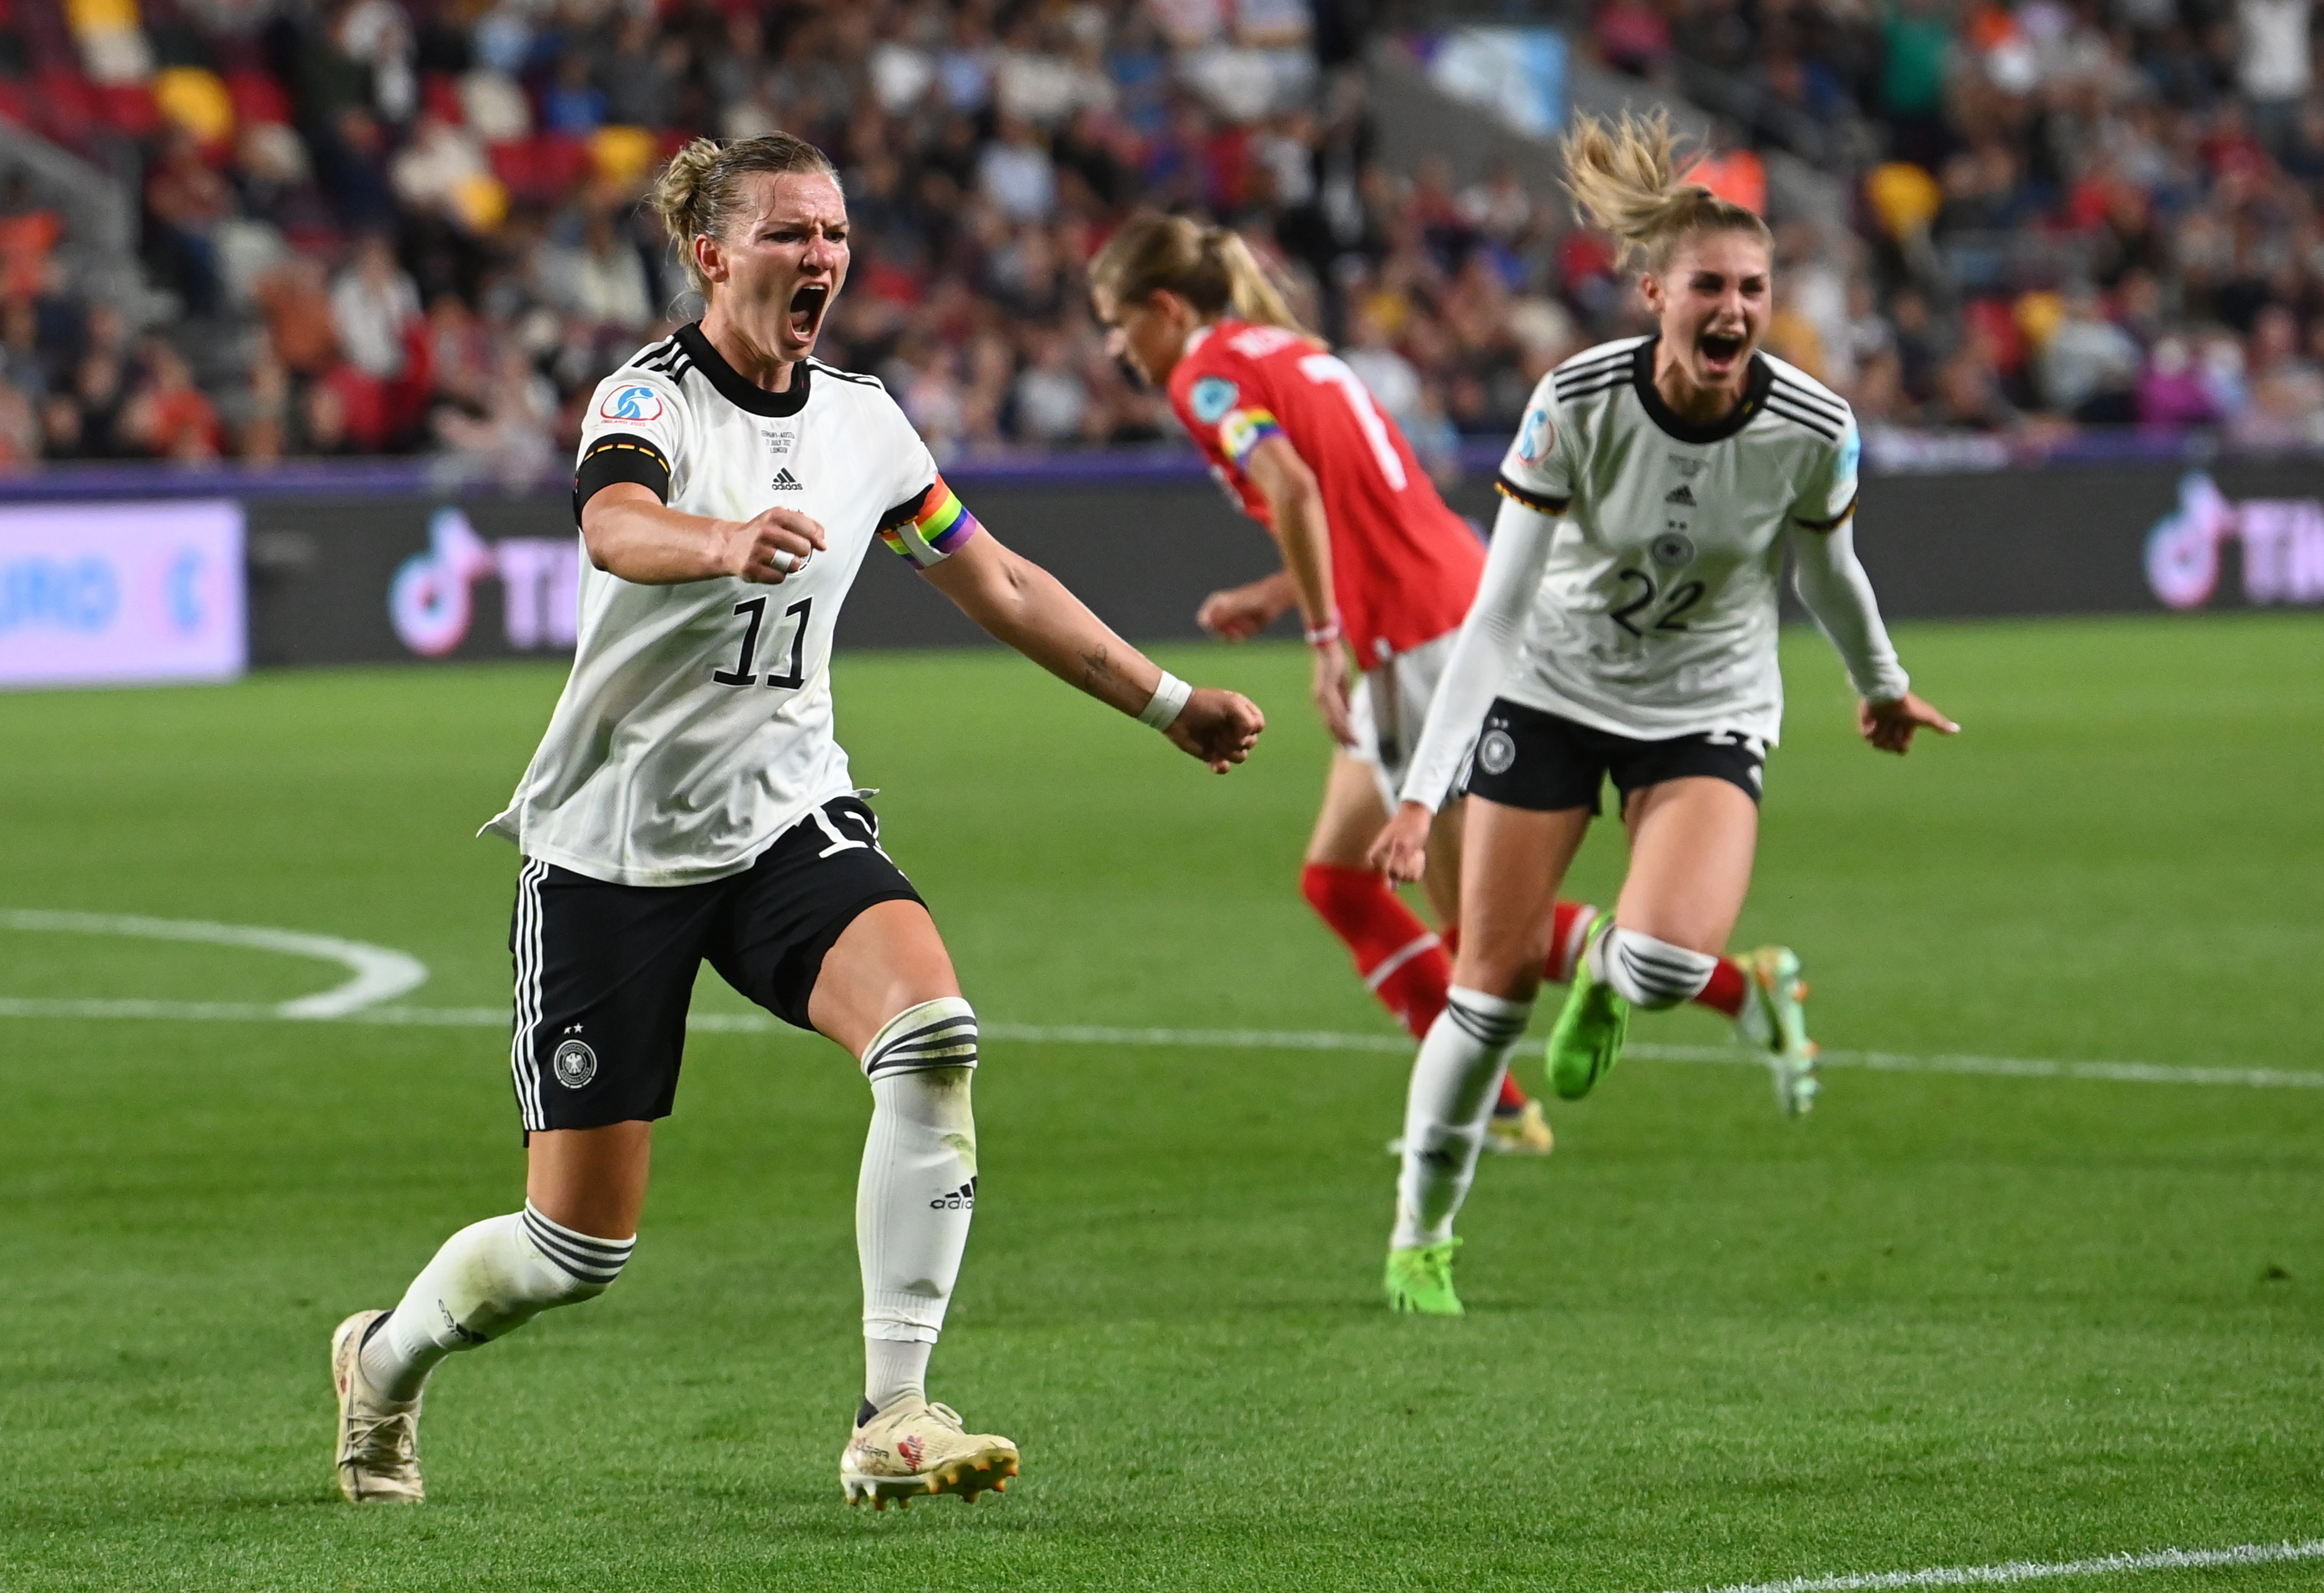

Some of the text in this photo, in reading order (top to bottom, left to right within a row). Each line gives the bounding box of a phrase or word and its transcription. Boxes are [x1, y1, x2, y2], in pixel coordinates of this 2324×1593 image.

[771, 481, 803, 491] adidas
[1609, 568, 1706, 638] 22
[712, 594, 814, 691] 11
[929, 1197, 973, 1210] adid
